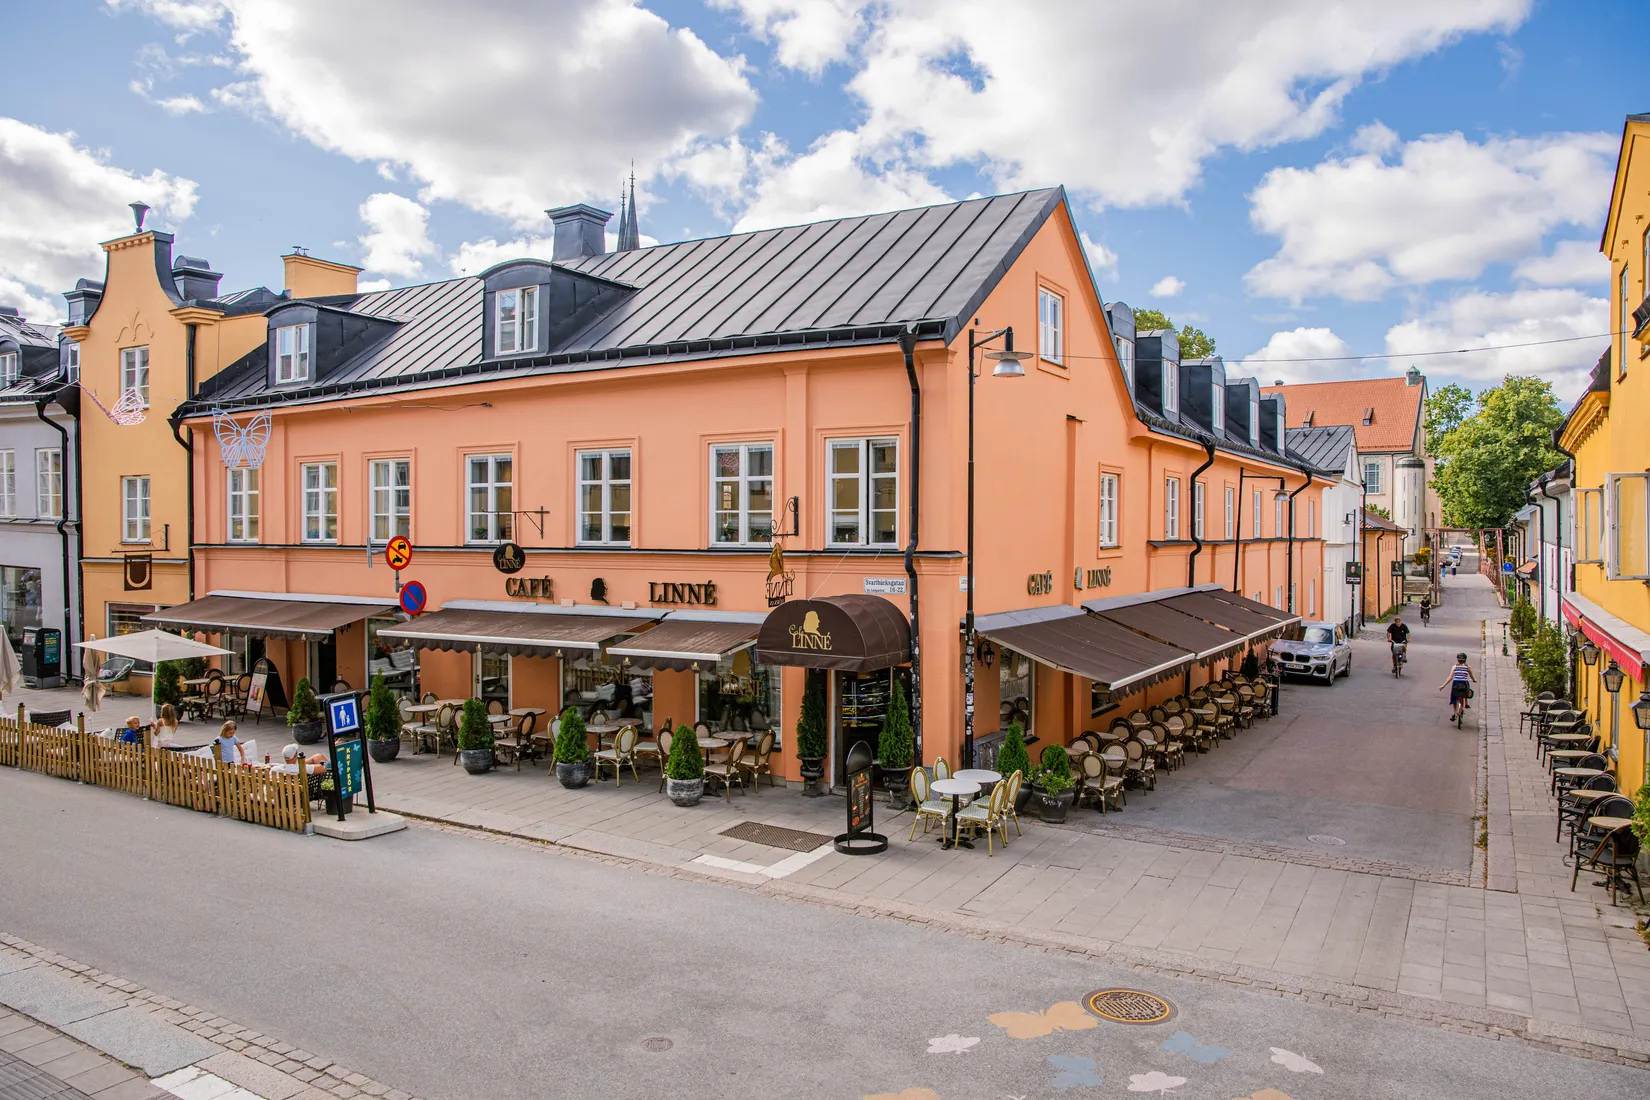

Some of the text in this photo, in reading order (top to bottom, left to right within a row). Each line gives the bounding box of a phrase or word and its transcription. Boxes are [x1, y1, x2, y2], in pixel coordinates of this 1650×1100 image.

[505, 575, 717, 605] CAFÉ LINNÉ
[1027, 565, 1111, 595] CAFÉ LINNÉ
[791, 632, 832, 651] LINNÉ
